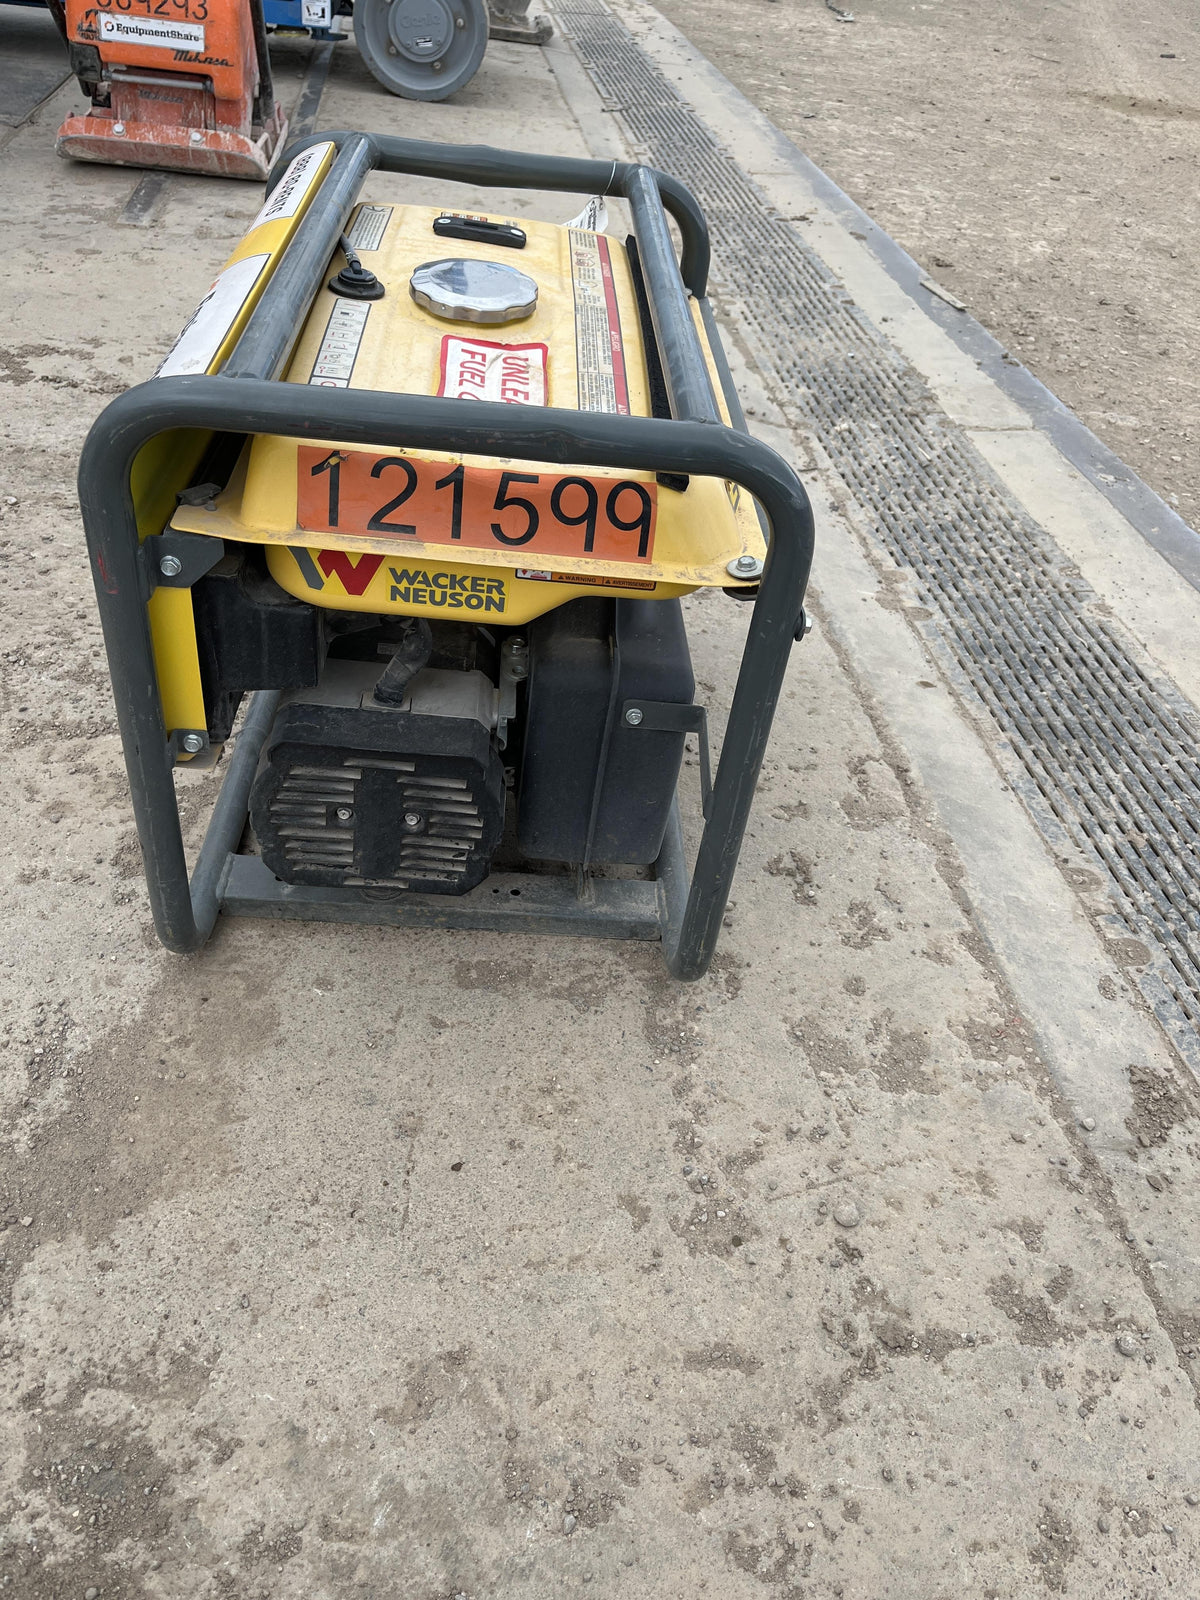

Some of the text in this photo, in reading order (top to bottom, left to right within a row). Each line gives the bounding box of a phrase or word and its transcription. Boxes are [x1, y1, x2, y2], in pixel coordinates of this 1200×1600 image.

[98, 0, 208, 20] 9293
[116, 23, 200, 42] EquipmentShare
[459, 348, 487, 388] FUEL
[311, 450, 651, 558] 121599
[389, 567, 506, 596] WACKER
[565, 575, 597, 583] WARNING
[390, 586, 506, 613] NEUSON
